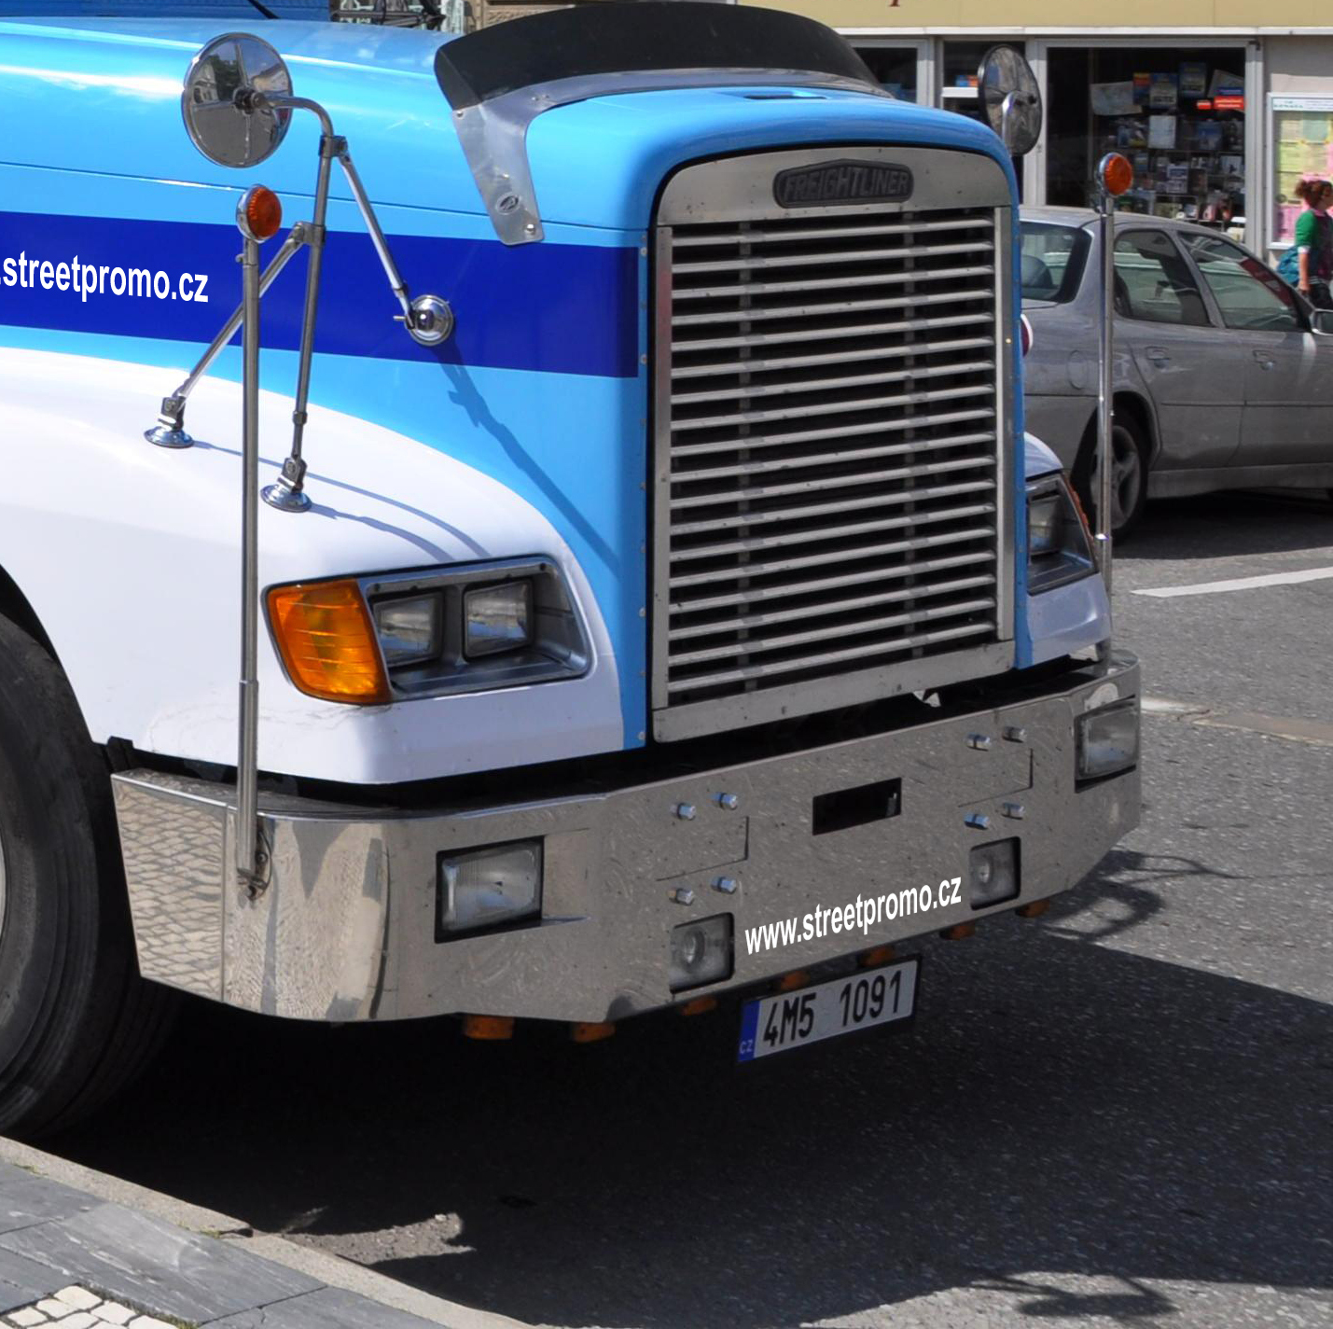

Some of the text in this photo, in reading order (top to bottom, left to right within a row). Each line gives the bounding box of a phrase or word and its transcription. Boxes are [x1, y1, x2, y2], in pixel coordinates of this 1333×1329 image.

[784, 166, 910, 200] FREIGHTLINER
[744, 876, 962, 956] www.streetpromo.cz
[739, 970, 903, 1055] CZ 4M5 1091
